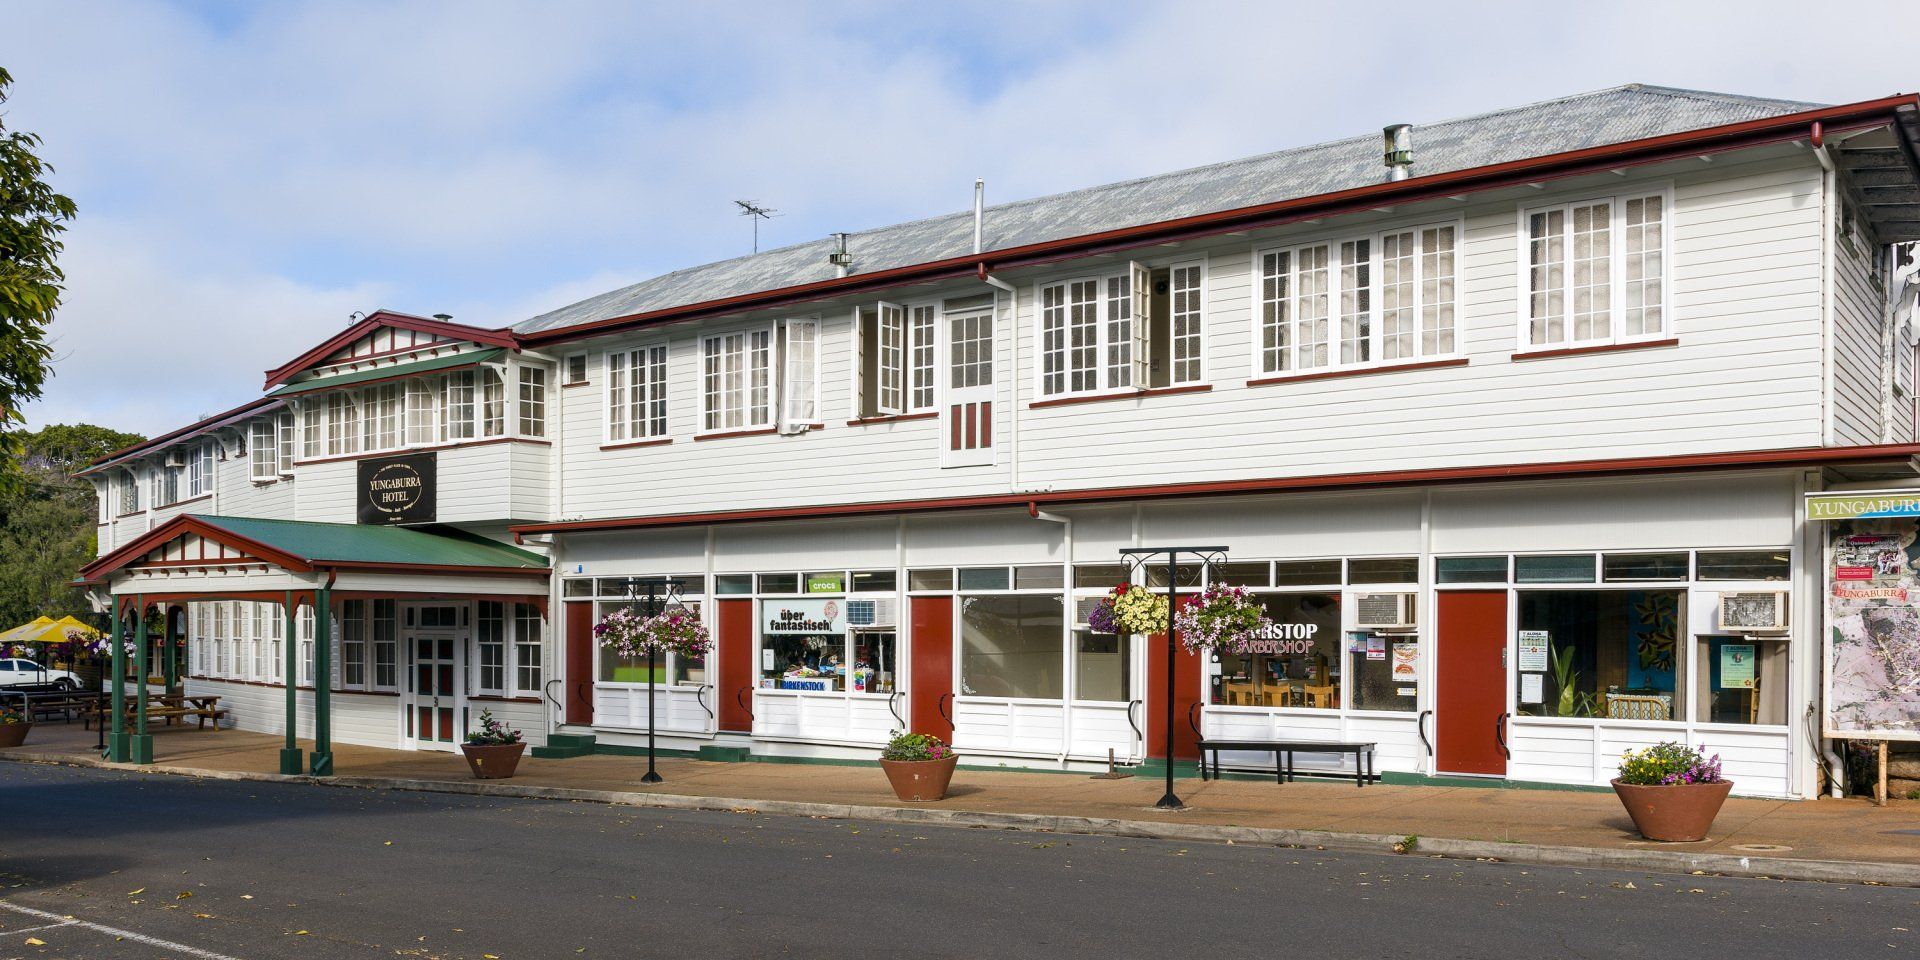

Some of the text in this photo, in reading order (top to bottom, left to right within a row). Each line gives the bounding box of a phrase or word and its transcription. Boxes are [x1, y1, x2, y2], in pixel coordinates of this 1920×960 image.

[370, 477, 421, 491] YUNGABURRA
[382, 491, 409, 503] HOTEL
[813, 582, 836, 590] crocs
[1839, 588, 1904, 599] YUNGABURRA
[780, 609, 805, 621] über
[770, 619, 830, 631] fantastisch
[1250, 623, 1318, 639] RSTOP
[1241, 640, 1315, 654] ARBERSHOP
[782, 680, 825, 691] BIRKENSTOCK
